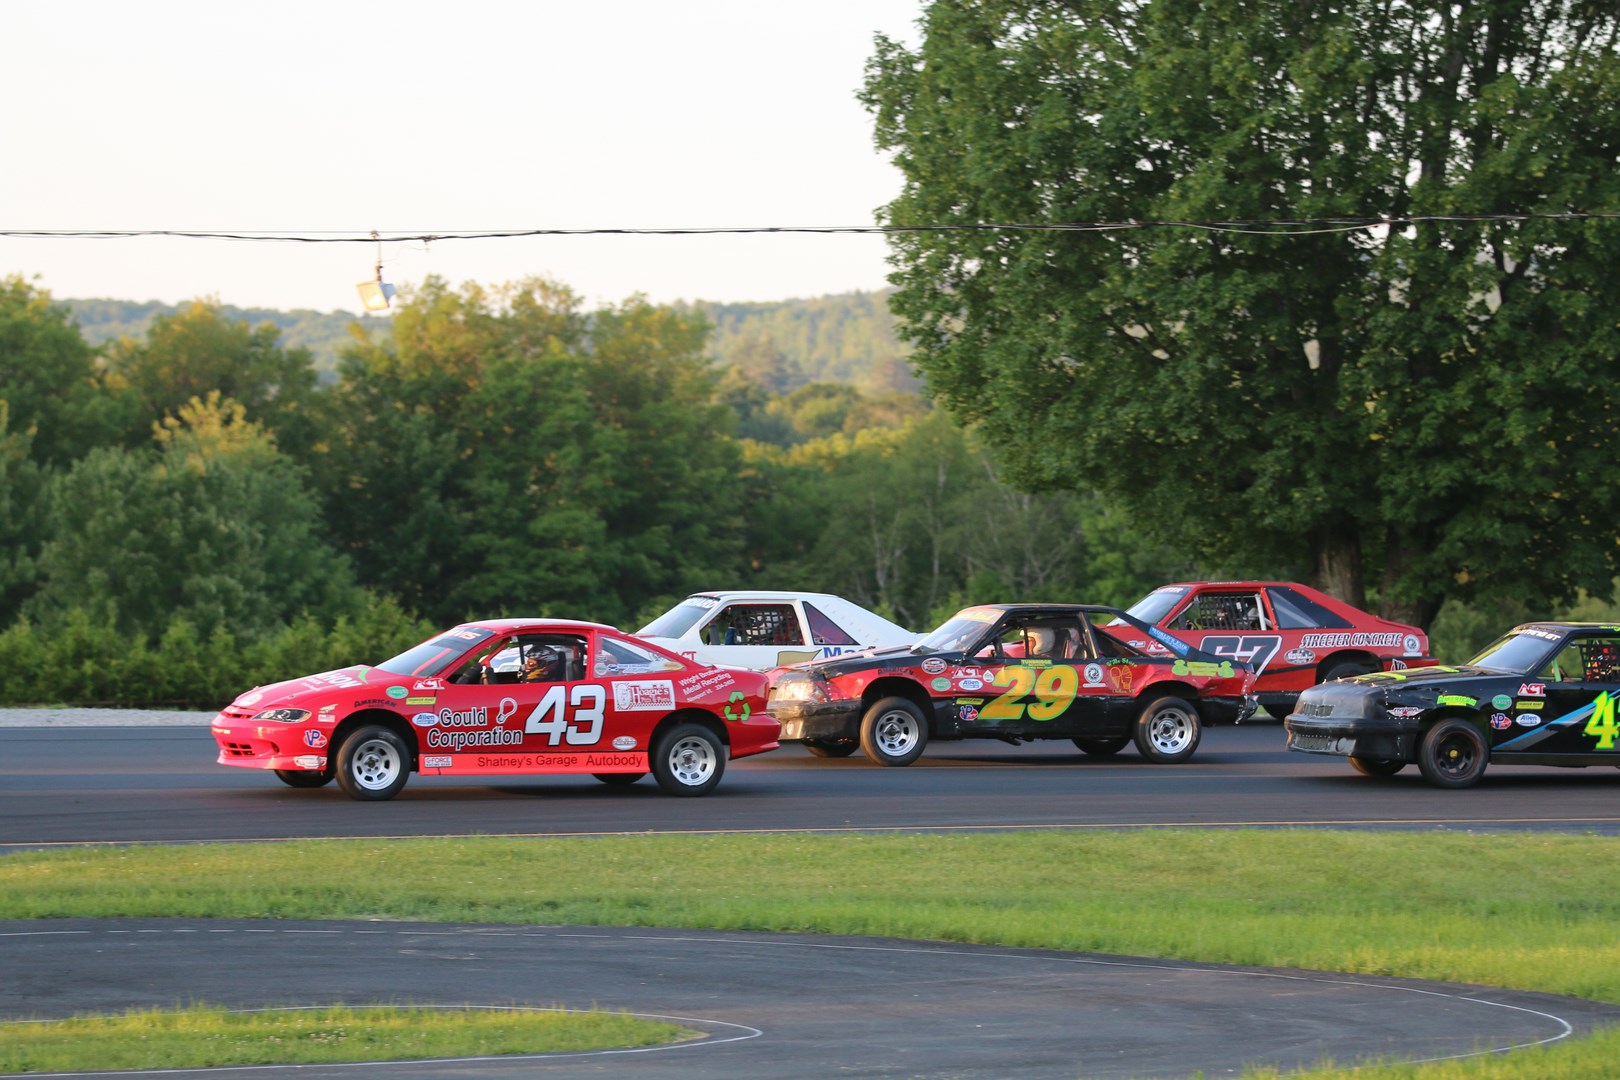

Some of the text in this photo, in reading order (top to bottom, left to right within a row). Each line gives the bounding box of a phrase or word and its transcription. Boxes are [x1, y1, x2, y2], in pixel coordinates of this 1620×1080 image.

[1300, 632, 1403, 648] STREETER CONCRETE
[953, 666, 982, 678] ACT
[413, 678, 444, 690] ACT
[682, 672, 732, 695] Metal Recycling
[1518, 683, 1547, 697] ACT
[630, 683, 670, 704] Hoagie's
[977, 664, 1079, 722] 29
[1437, 695, 1477, 706] AMERICAN
[440, 706, 487, 727] Gould
[523, 683, 607, 747] 43
[961, 705, 974, 720] VP
[1584, 690, 1620, 750] 4
[1492, 713, 1505, 729] VP
[305, 730, 321, 746] VP
[427, 726, 523, 751] Corporation
[478, 755, 643, 769] Shatney's Garage Autobody
